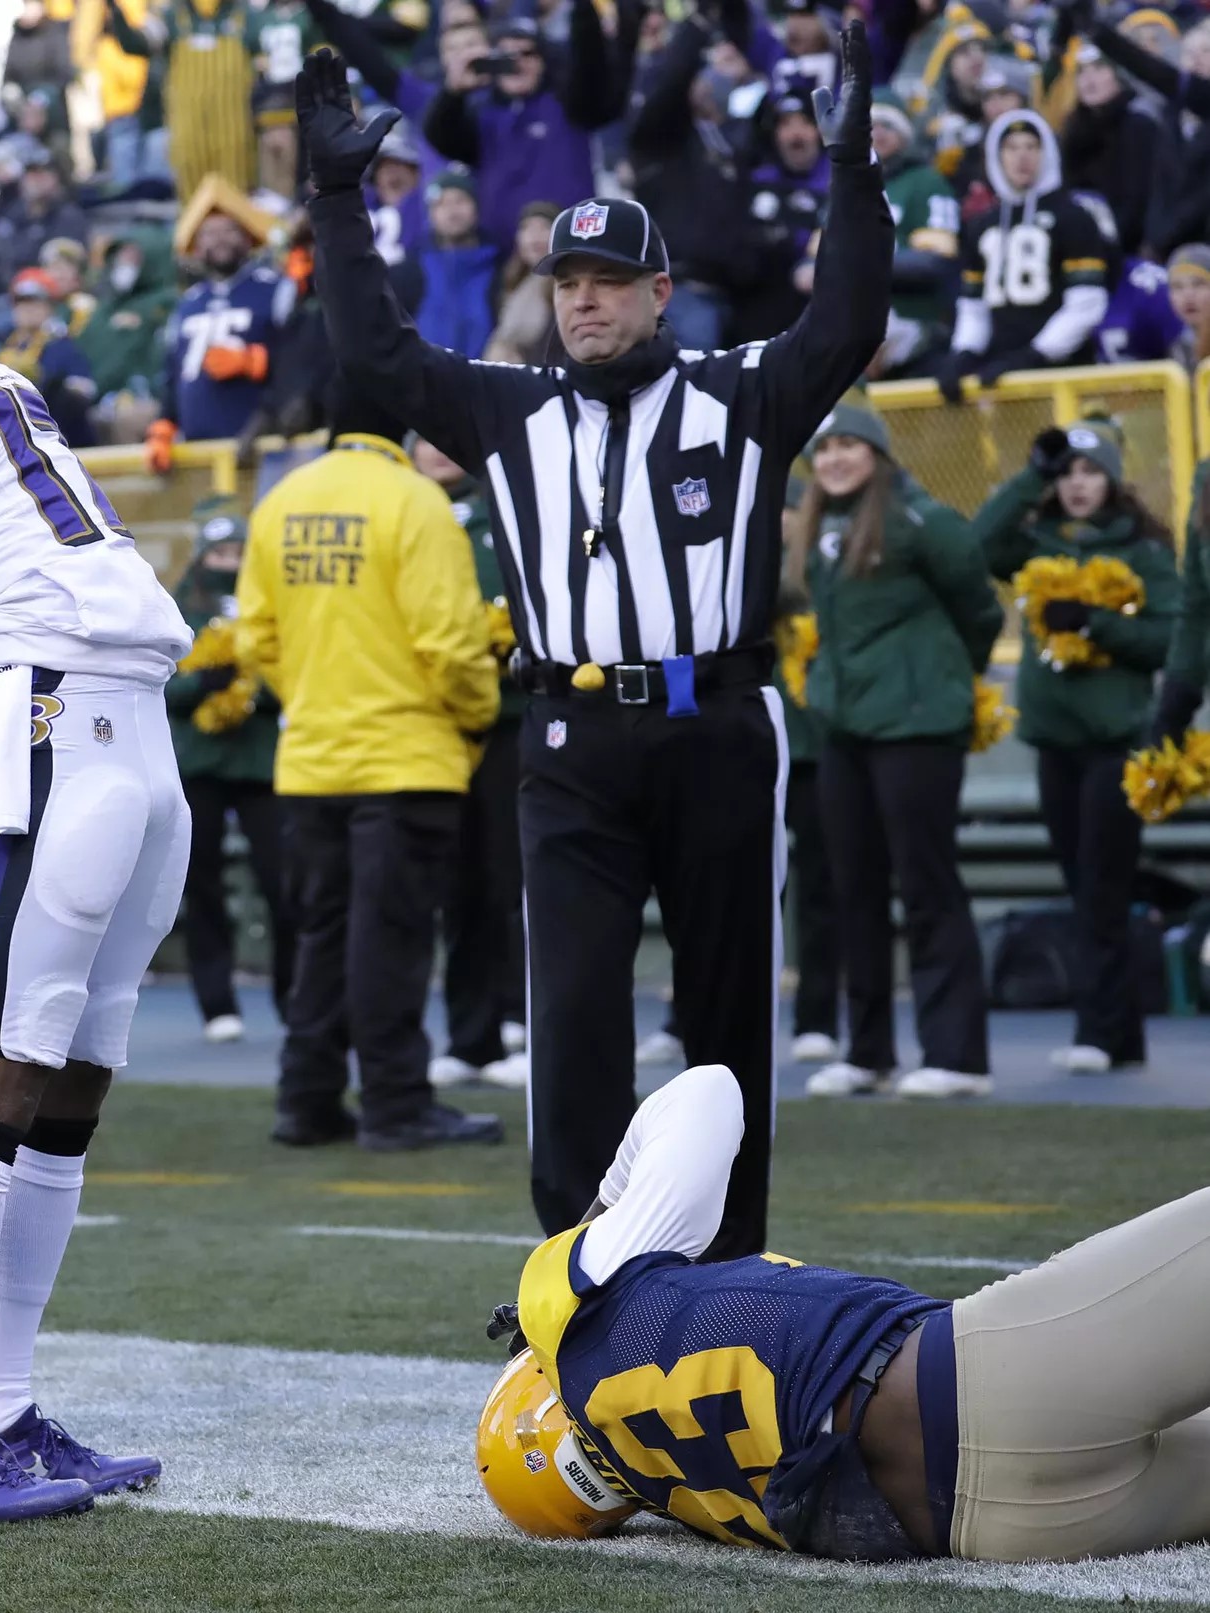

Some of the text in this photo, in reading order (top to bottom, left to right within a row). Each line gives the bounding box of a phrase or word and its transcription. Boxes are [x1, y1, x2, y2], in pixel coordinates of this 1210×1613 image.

[979, 224, 1050, 308] 18
[284, 513, 367, 548] EVENT
[284, 552, 364, 586] STAFF
[96, 726, 113, 740] NFL
[533, 1449, 547, 1470] NFL
[564, 1460, 606, 1504] PACKERS
